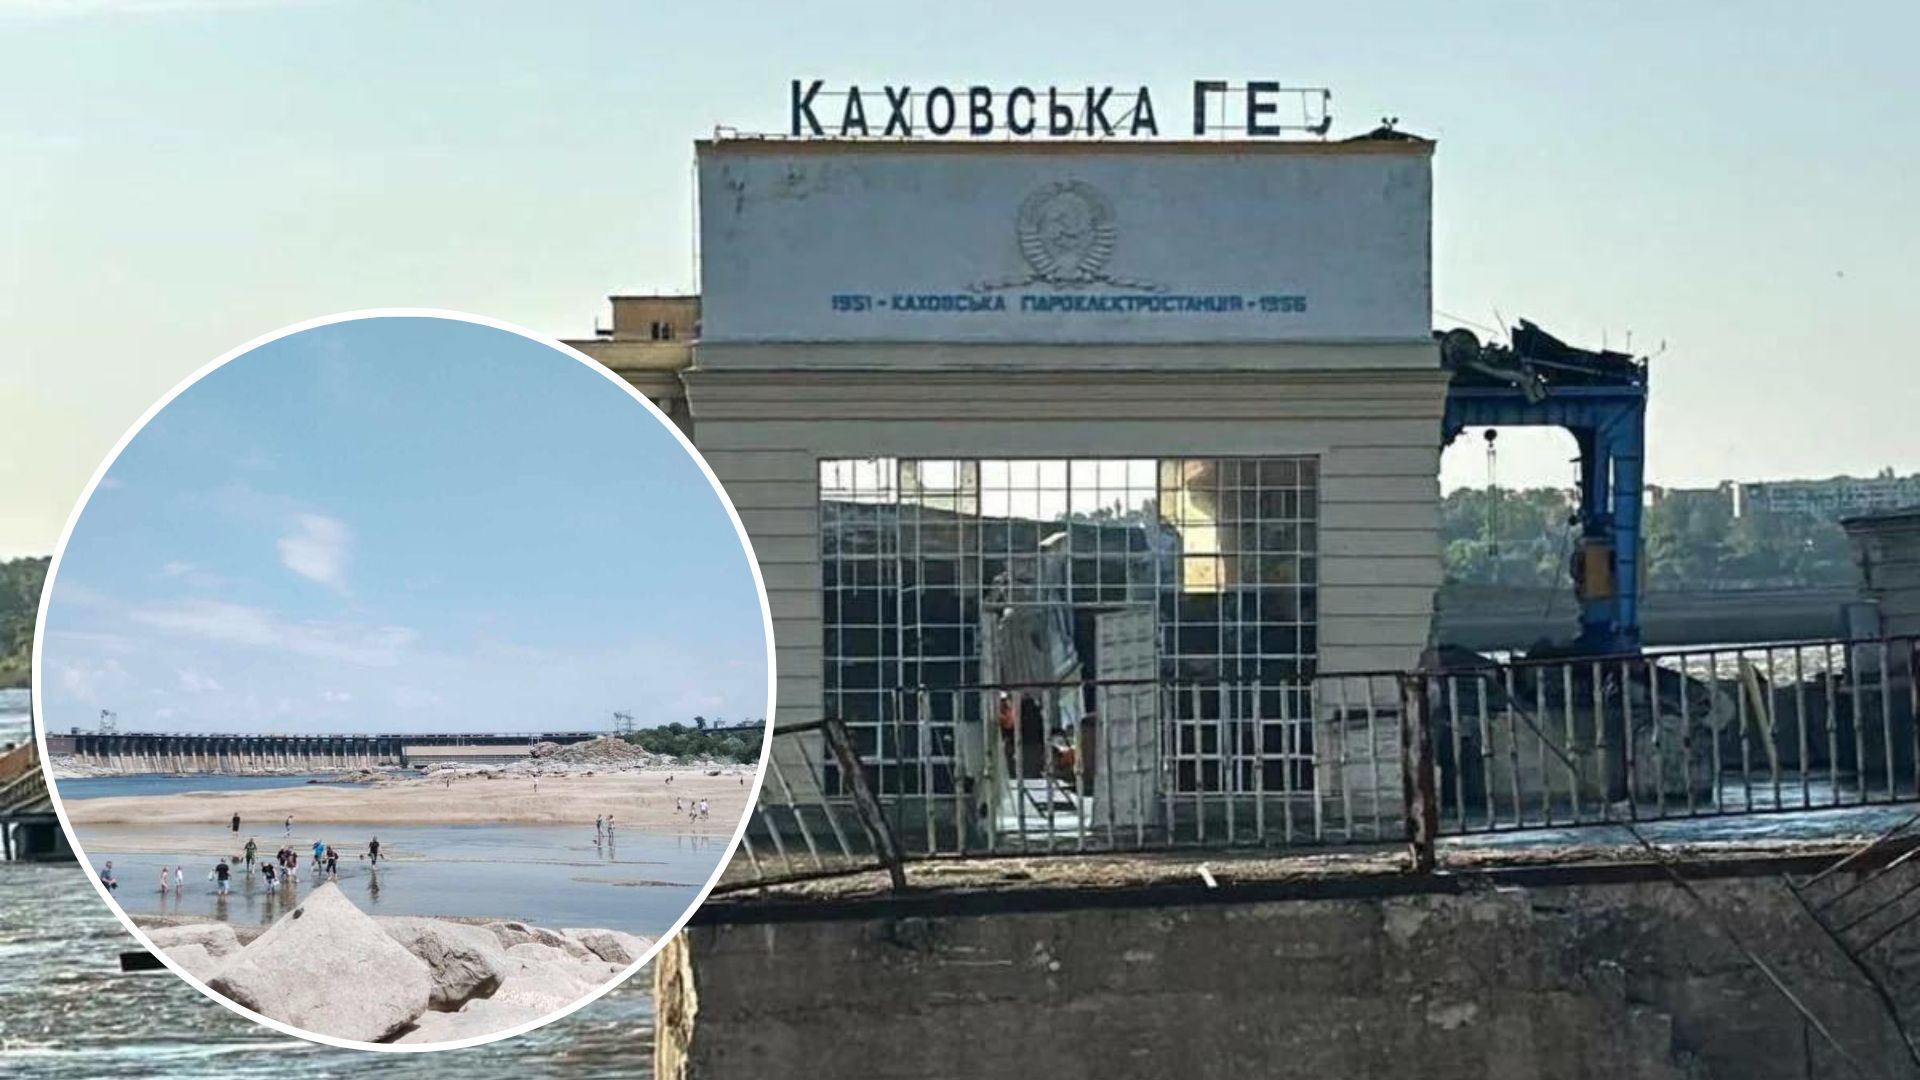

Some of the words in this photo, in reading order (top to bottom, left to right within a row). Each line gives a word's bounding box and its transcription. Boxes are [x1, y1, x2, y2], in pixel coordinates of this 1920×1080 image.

[792, 80, 1158, 136] КАХОВСЬКА
[832, 294, 872, 312] 1951
[892, 294, 1006, 312] КАХОВСЬКА
[1259, 296, 1307, 313] 1956
